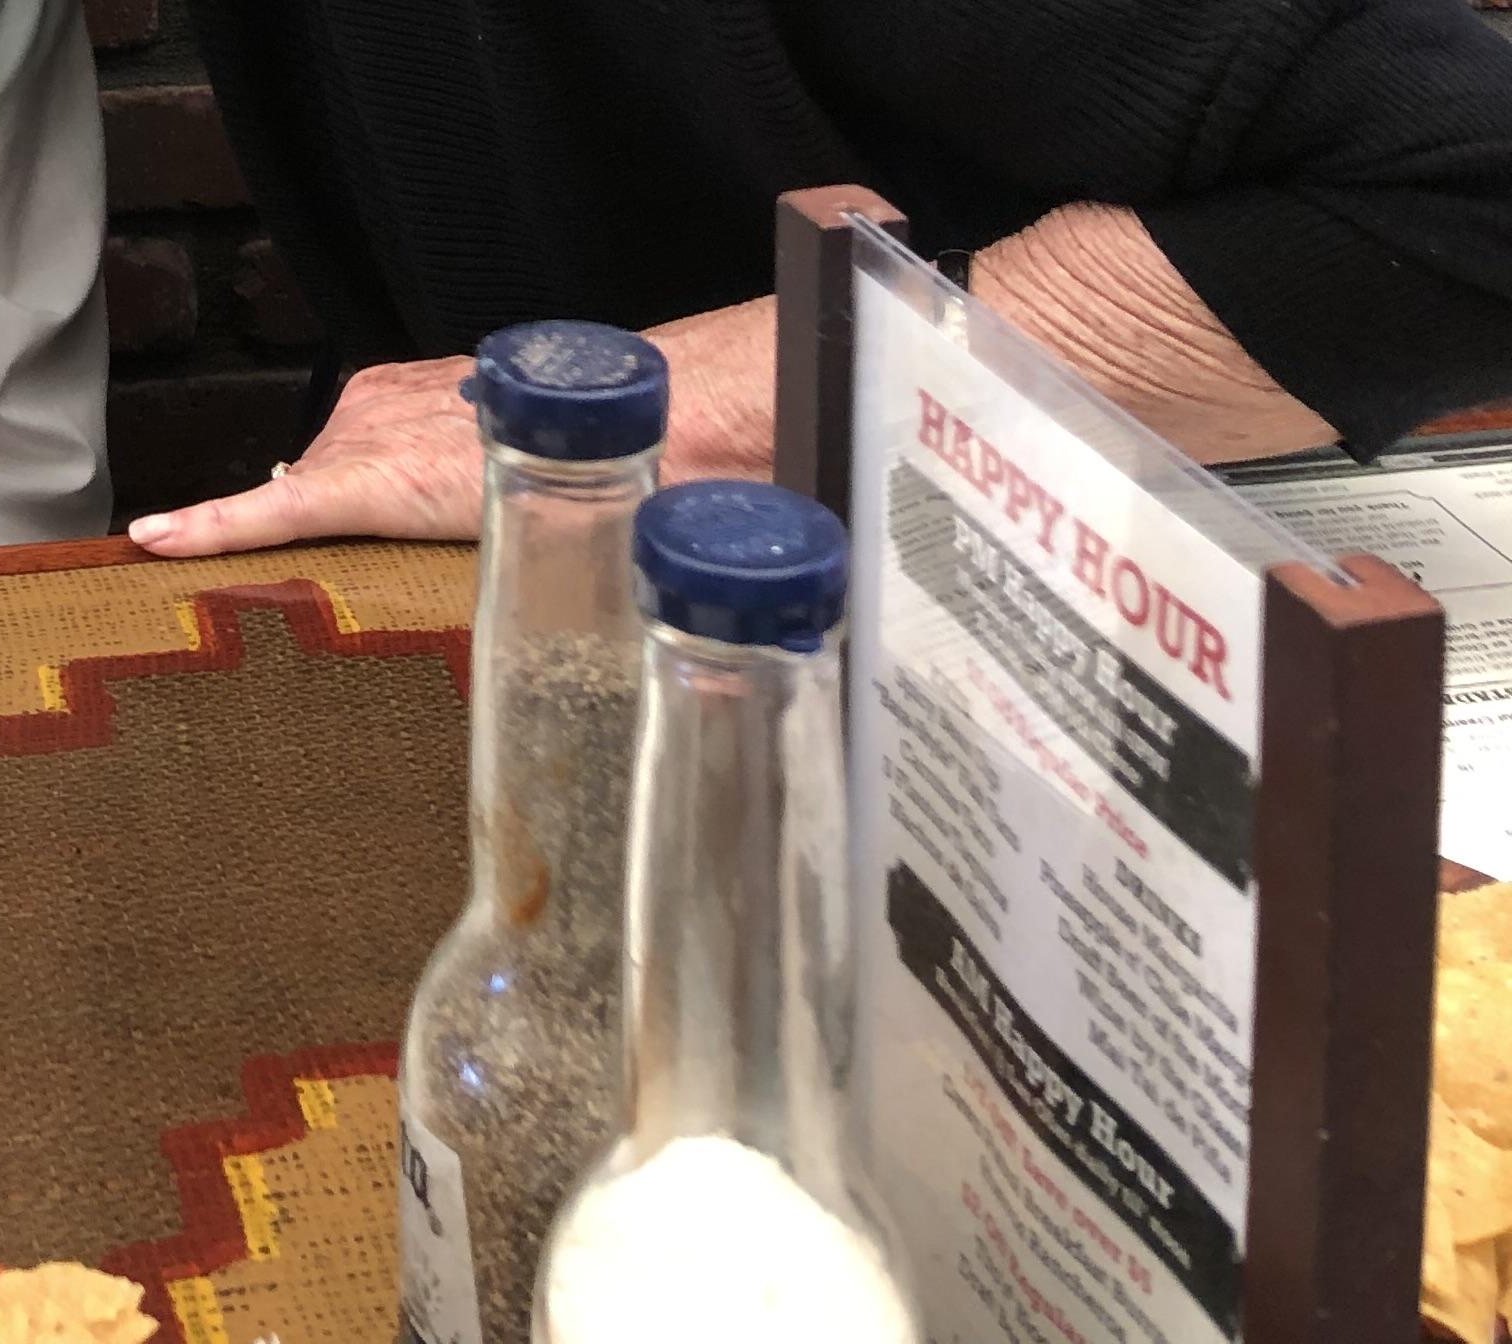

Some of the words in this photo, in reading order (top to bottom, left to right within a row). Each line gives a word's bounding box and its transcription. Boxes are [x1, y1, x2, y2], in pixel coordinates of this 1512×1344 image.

[917, 386, 1065, 555] HAPPY
[1070, 517, 1232, 702] HOUR
[1092, 647, 1178, 745] Hour
[951, 935, 989, 1012] AM
[993, 994, 1084, 1125] Happy
[1089, 1100, 1176, 1210] Hour
